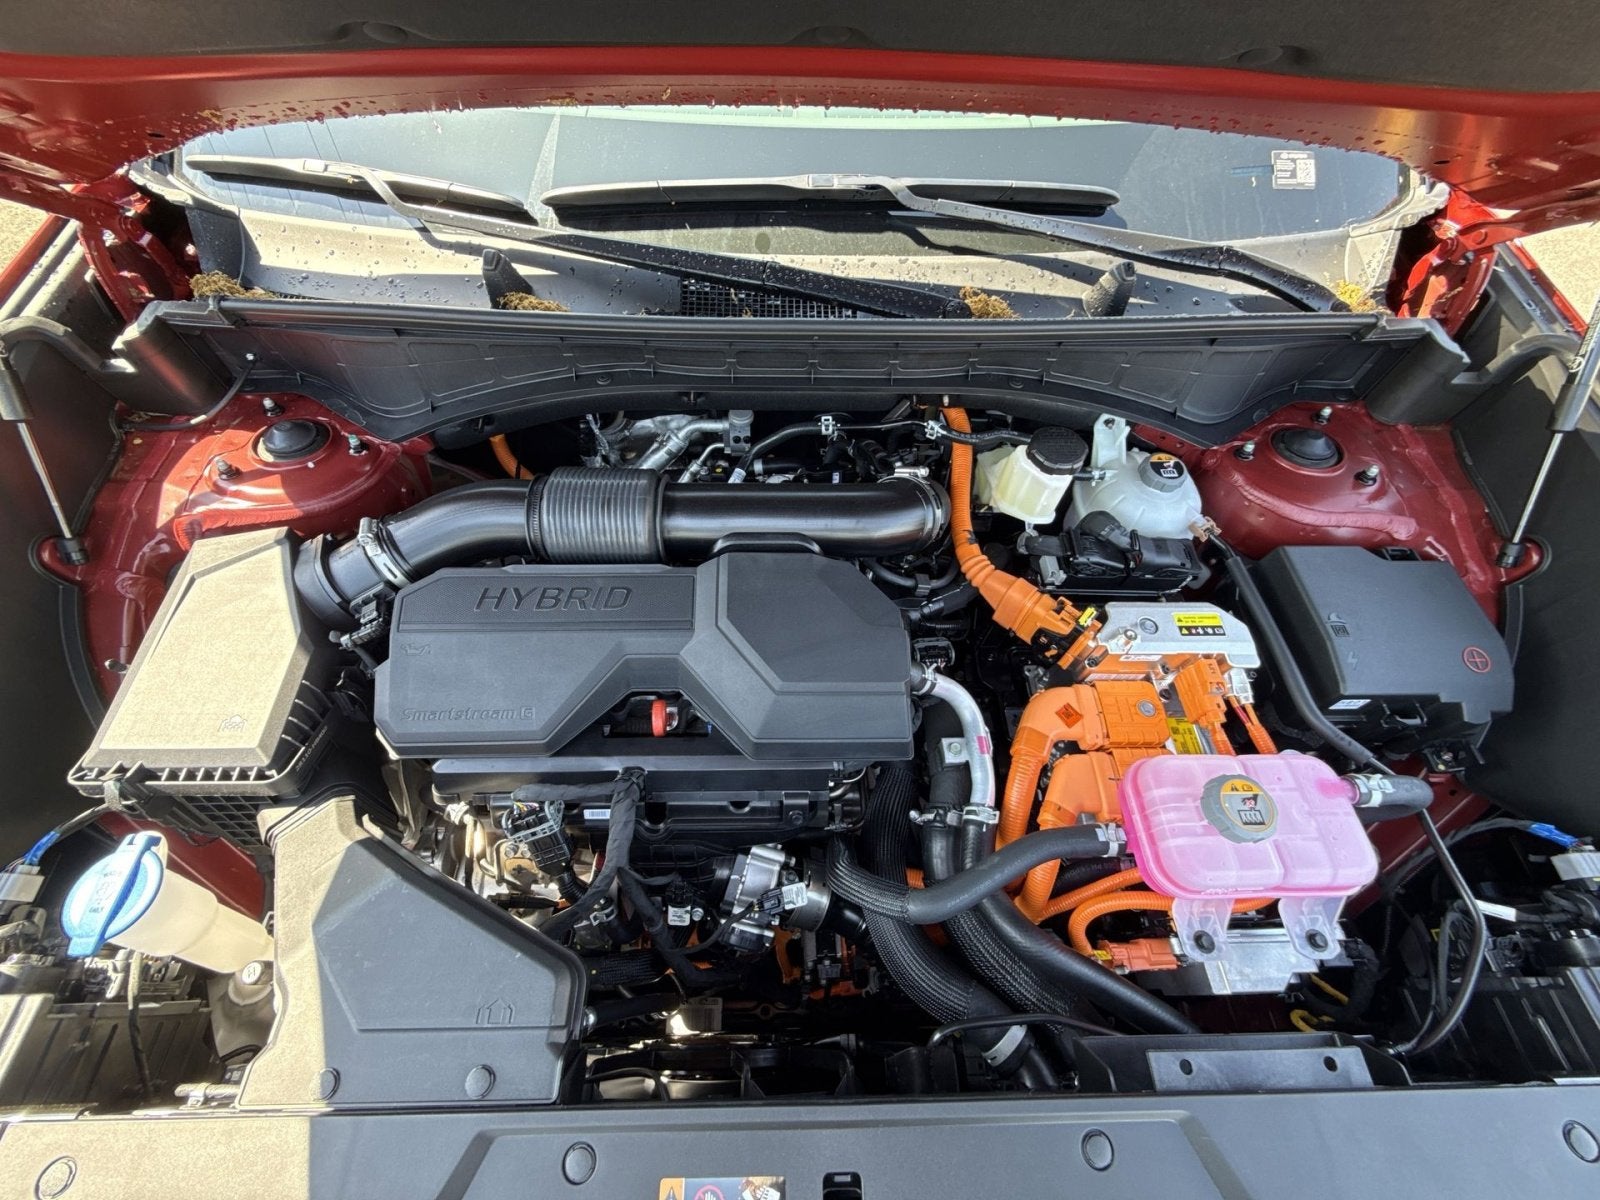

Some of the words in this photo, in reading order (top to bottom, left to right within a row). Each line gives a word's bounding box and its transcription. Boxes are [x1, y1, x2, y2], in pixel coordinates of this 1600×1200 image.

[474, 586, 633, 612] HYBRID
[401, 708, 517, 721] Smartstream
[520, 706, 535, 721] G
